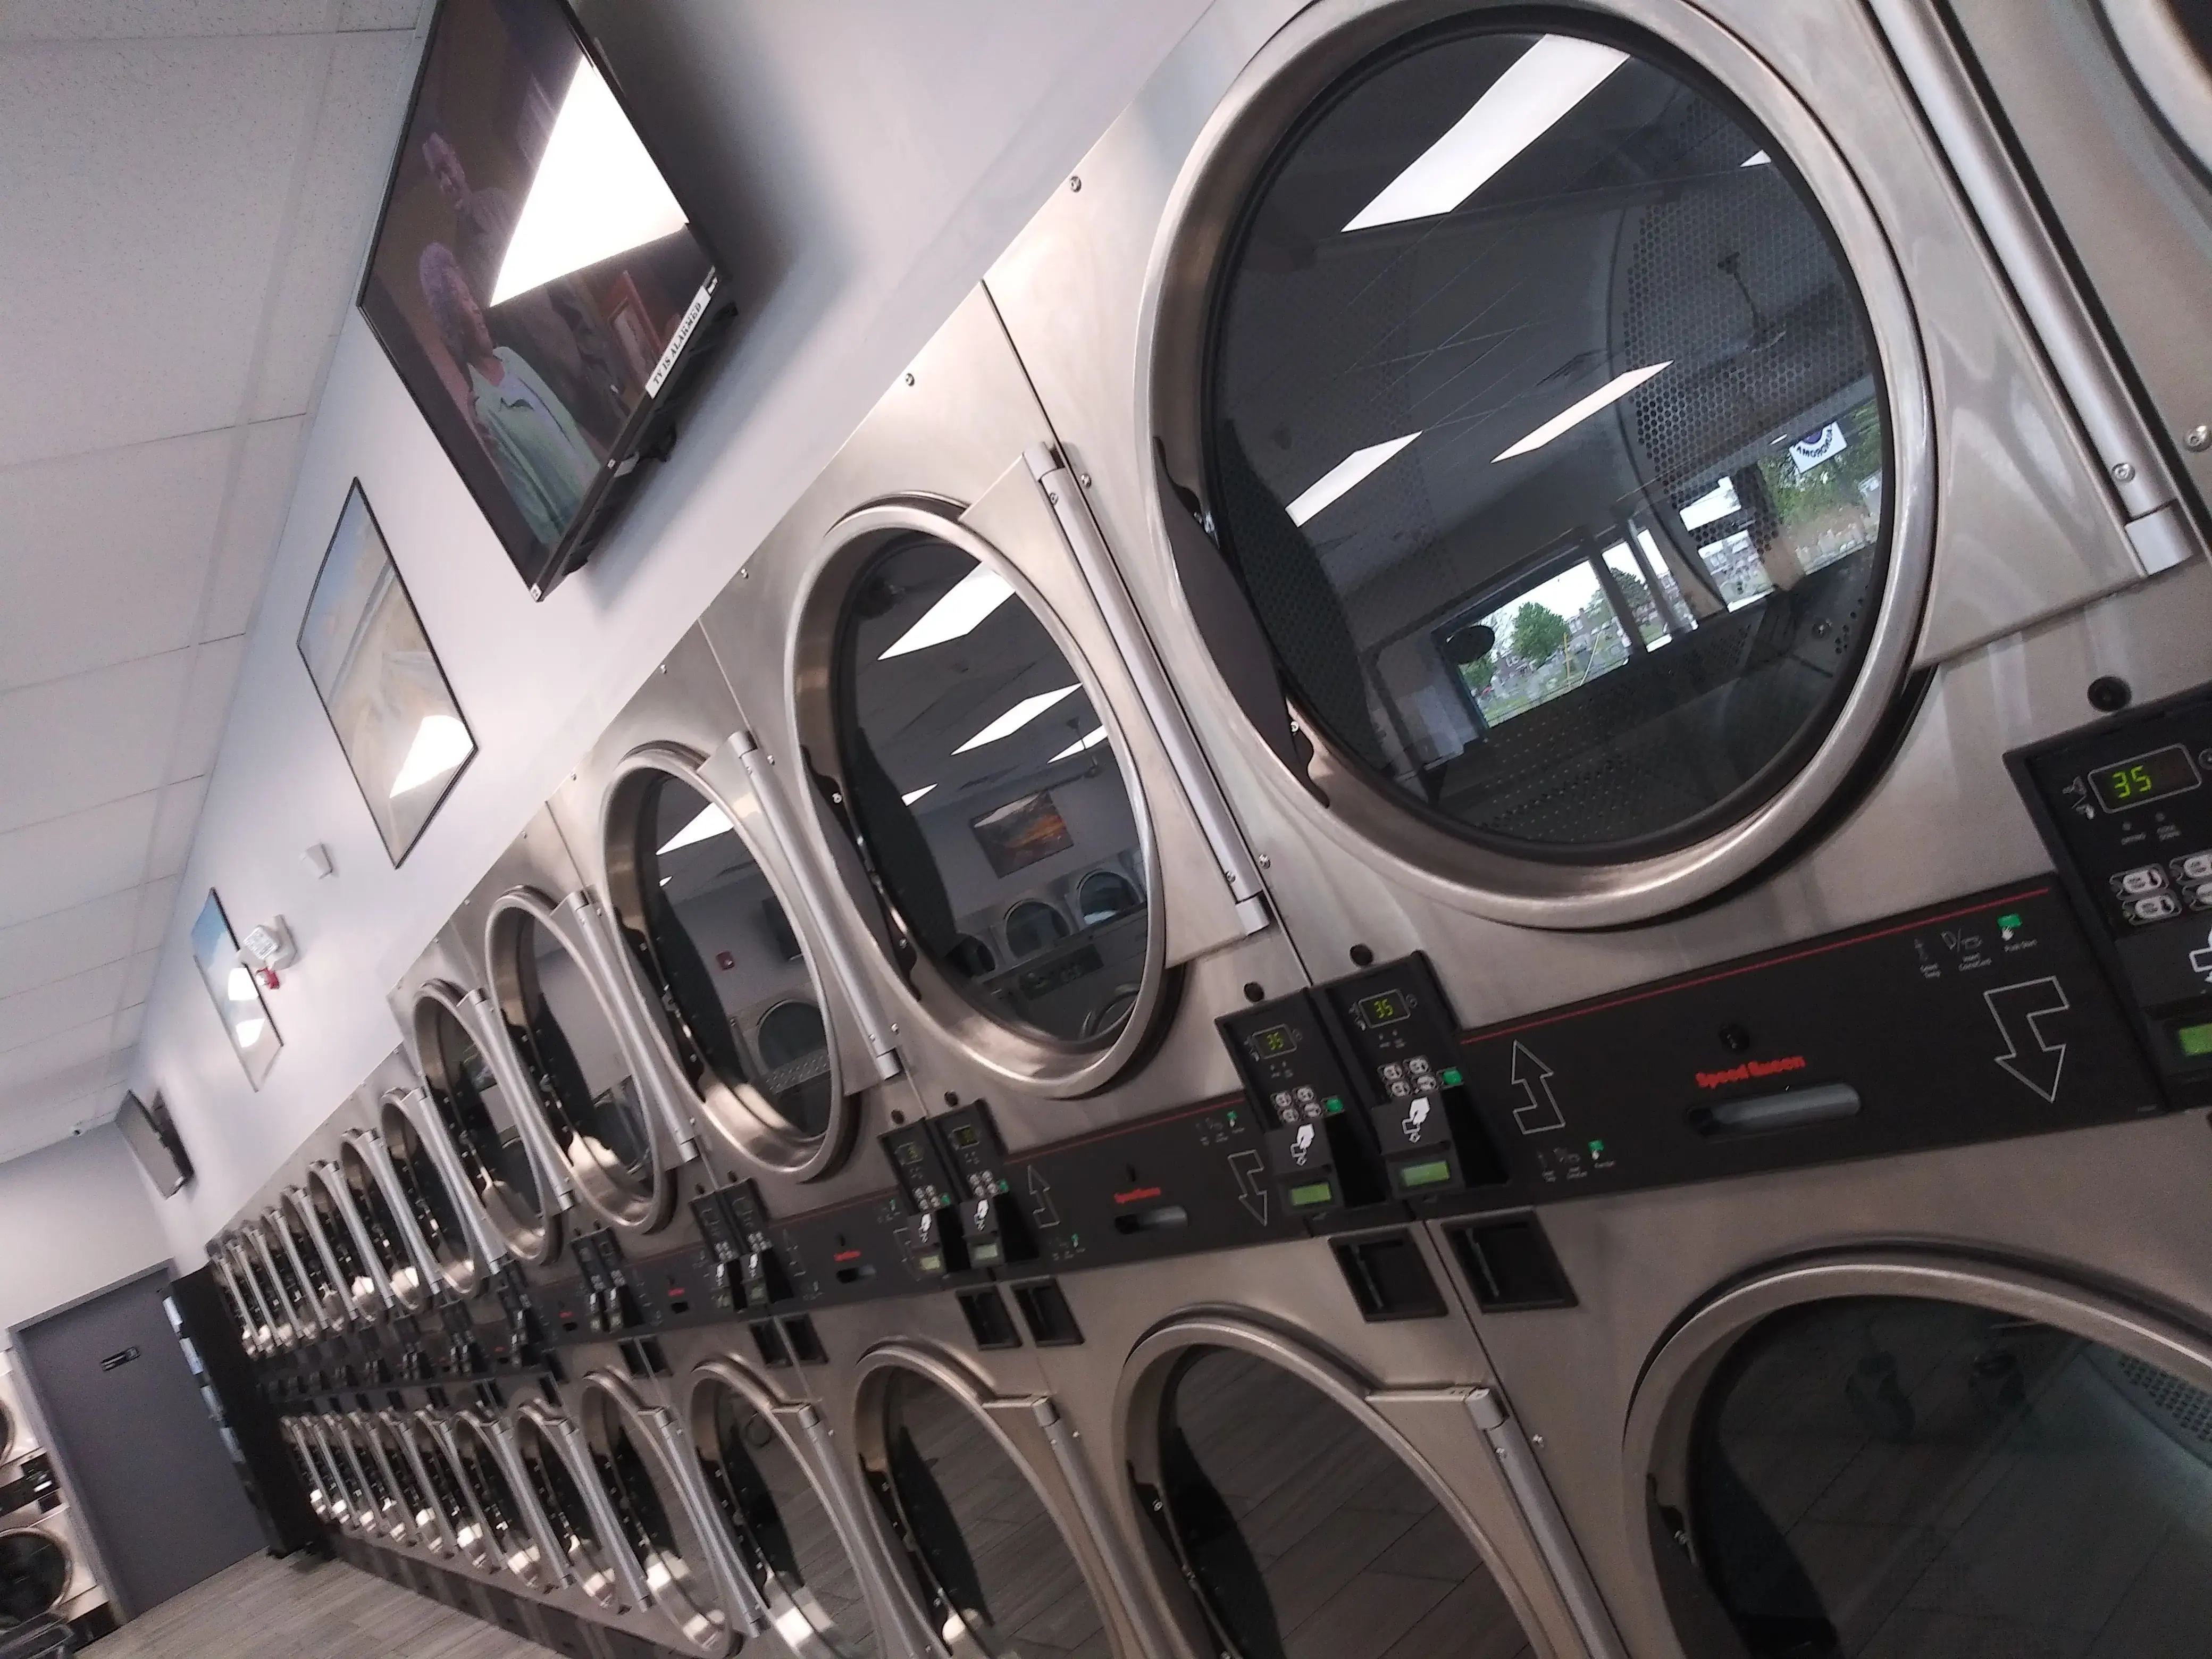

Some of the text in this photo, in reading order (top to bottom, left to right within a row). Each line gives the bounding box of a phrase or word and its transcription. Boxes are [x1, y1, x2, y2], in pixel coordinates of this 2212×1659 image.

[653, 303, 702, 385] TV IS ALARMED
[2112, 765, 2152, 798] 35
[1374, 999, 1394, 1018] 35
[1267, 1032, 1284, 1051] 35
